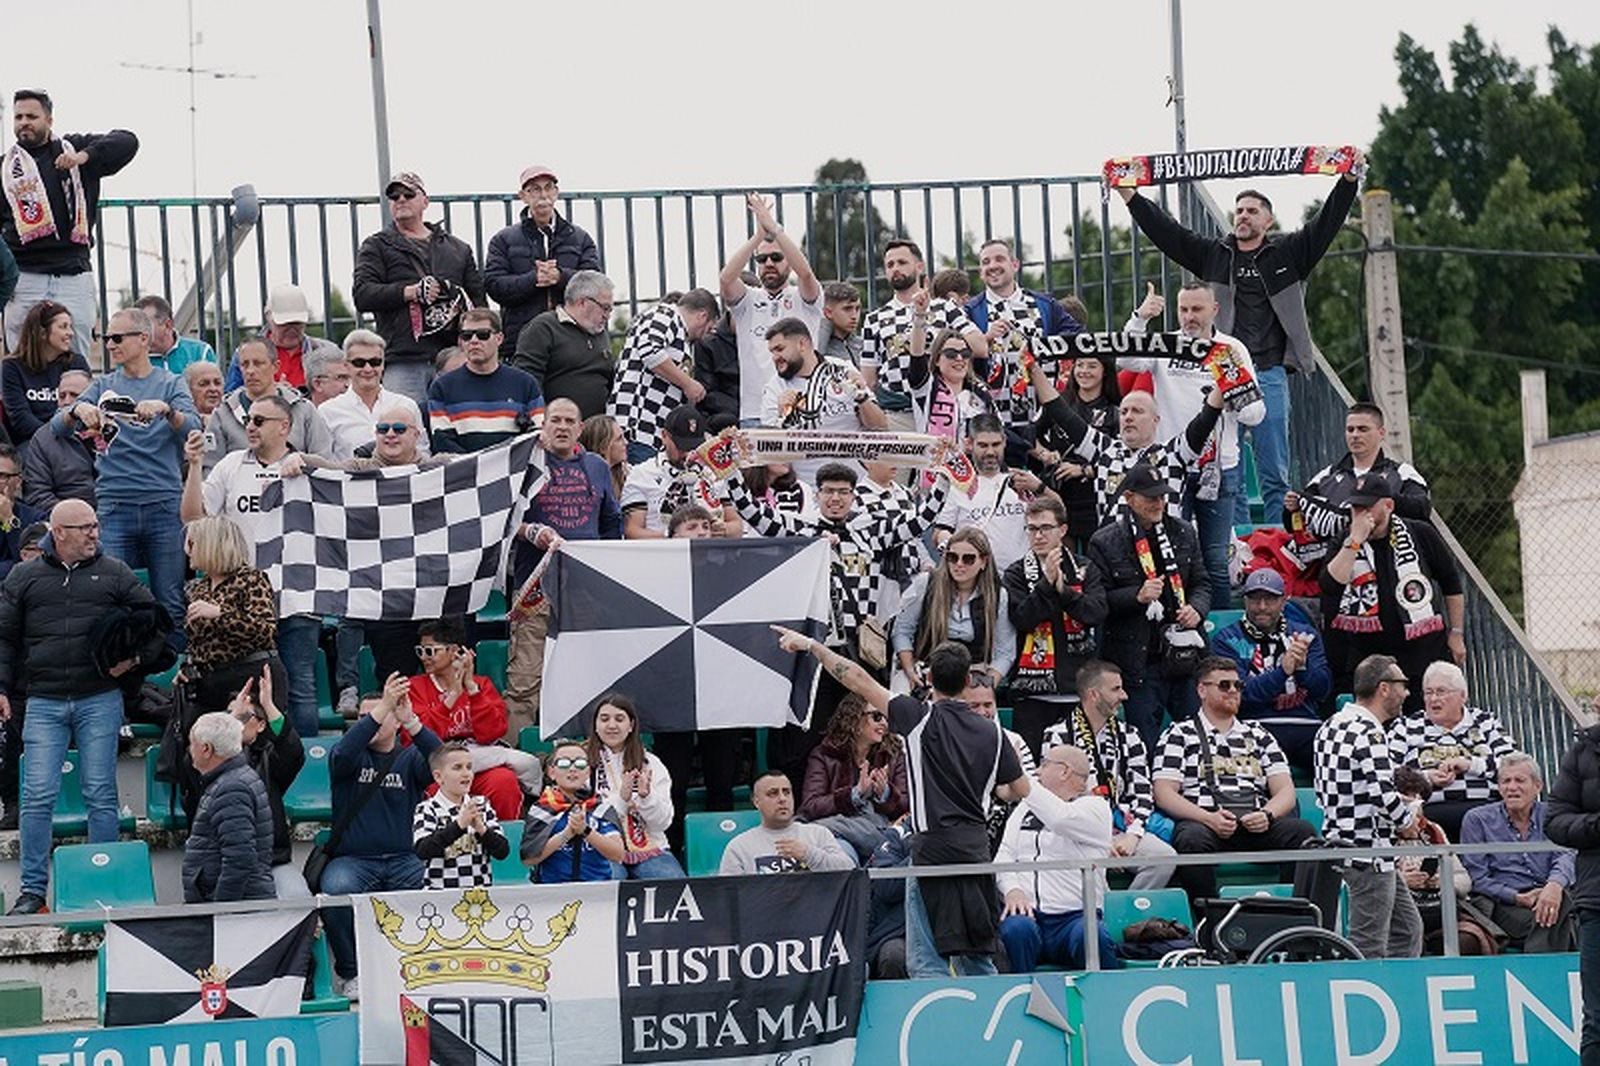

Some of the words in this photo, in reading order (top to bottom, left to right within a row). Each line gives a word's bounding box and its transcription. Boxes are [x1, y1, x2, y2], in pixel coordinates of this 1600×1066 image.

[1153, 146, 1304, 179] #BENDITALOCURA#
[1032, 335, 1068, 358] AD
[1075, 332, 1168, 353] CEUTA
[1176, 336, 1212, 358] FC
[26, 386, 59, 401] adid
[757, 440, 783, 452] UNA
[838, 442, 866, 453] NOS
[625, 929, 850, 987] HISTORIA
[632, 1000, 749, 1052] ESTÁ
[756, 995, 847, 1043] MAL
